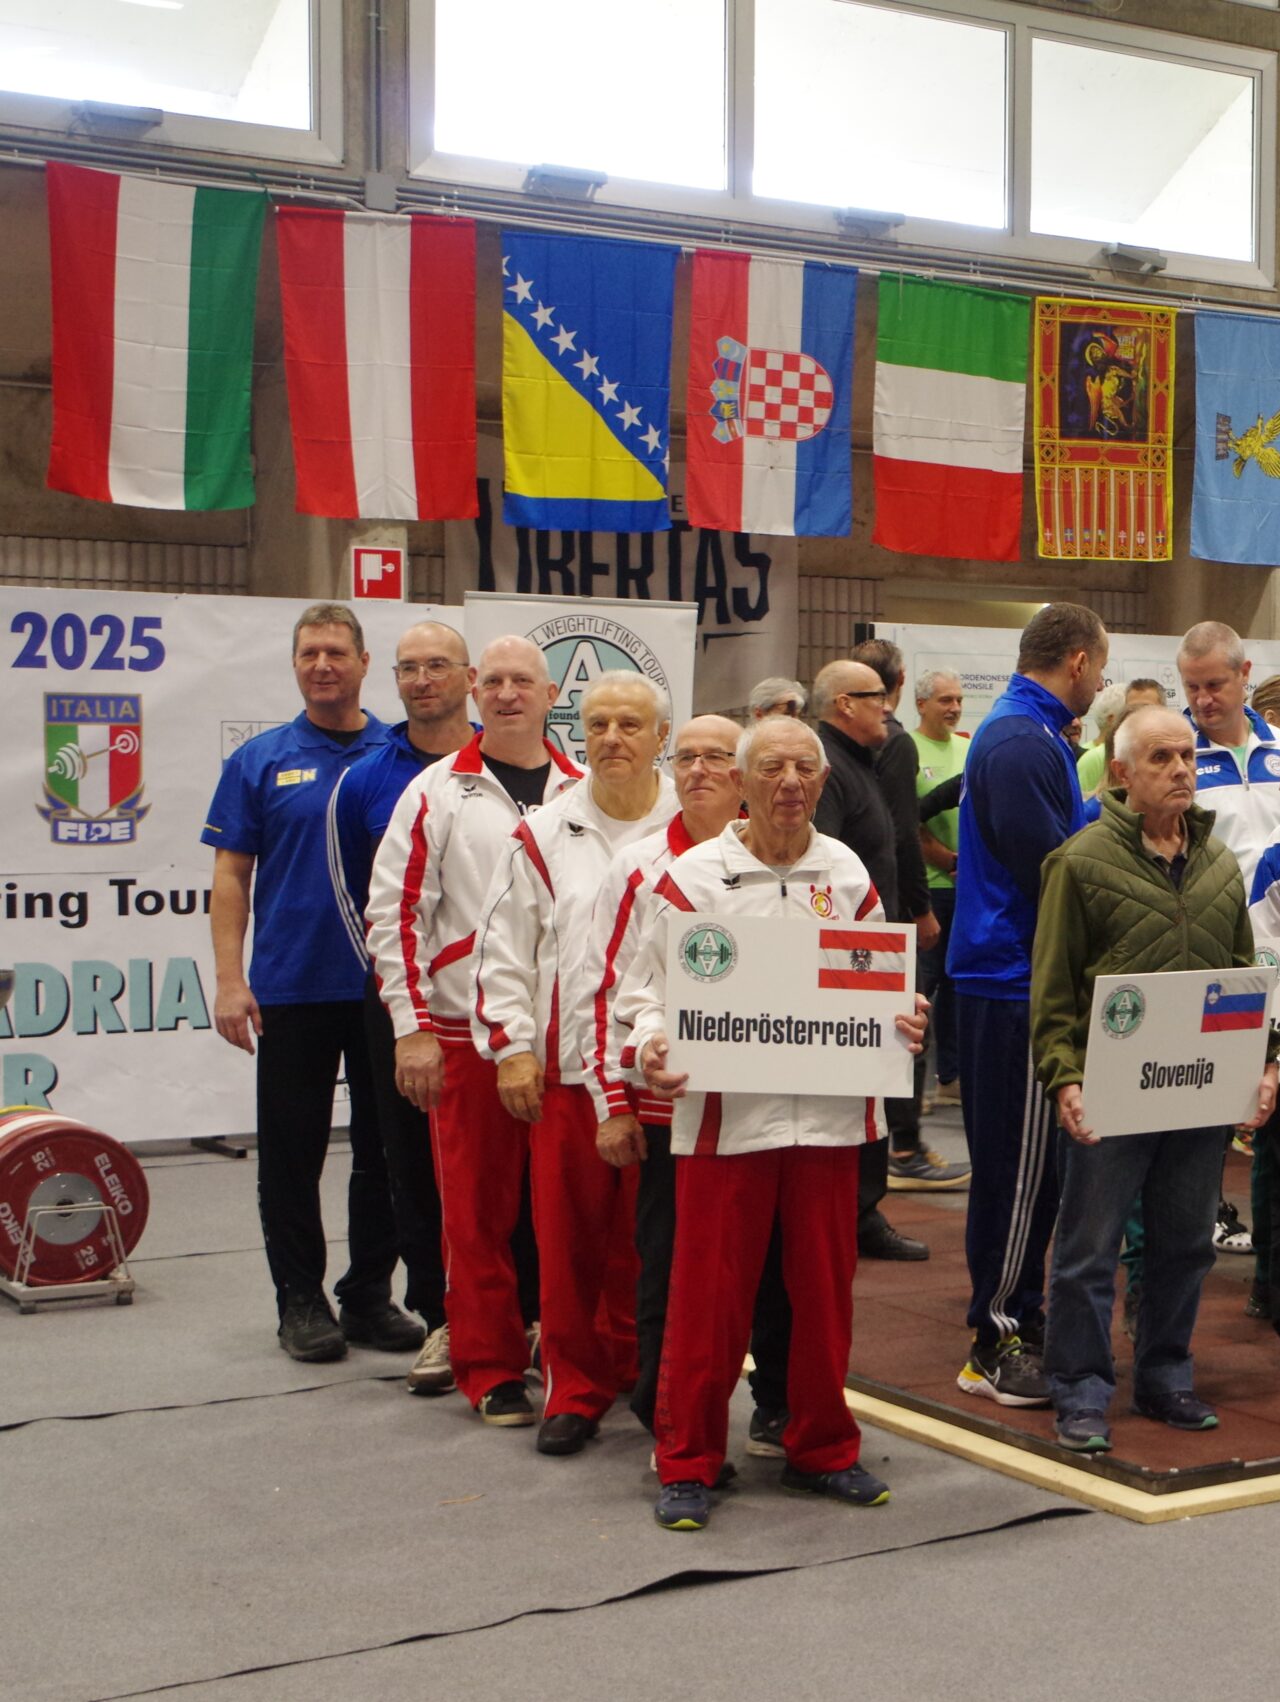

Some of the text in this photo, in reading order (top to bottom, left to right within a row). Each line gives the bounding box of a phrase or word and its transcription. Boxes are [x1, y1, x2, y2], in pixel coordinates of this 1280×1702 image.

[10, 611, 166, 672] 2025
[542, 617, 644, 655] WEIGHTLIFTING
[960, 673, 1010, 683] ORDENONESE
[51, 699, 136, 719] ITALIA
[57, 821, 131, 842] FIPE
[0, 882, 89, 929] ing
[678, 1010, 882, 1048] Niederösterreich
[1140, 1058, 1215, 1090] Slovenija
[31, 1151, 50, 1172] 25
[94, 1152, 134, 1216] ELEIKO
[79, 1245, 99, 1267] 25
